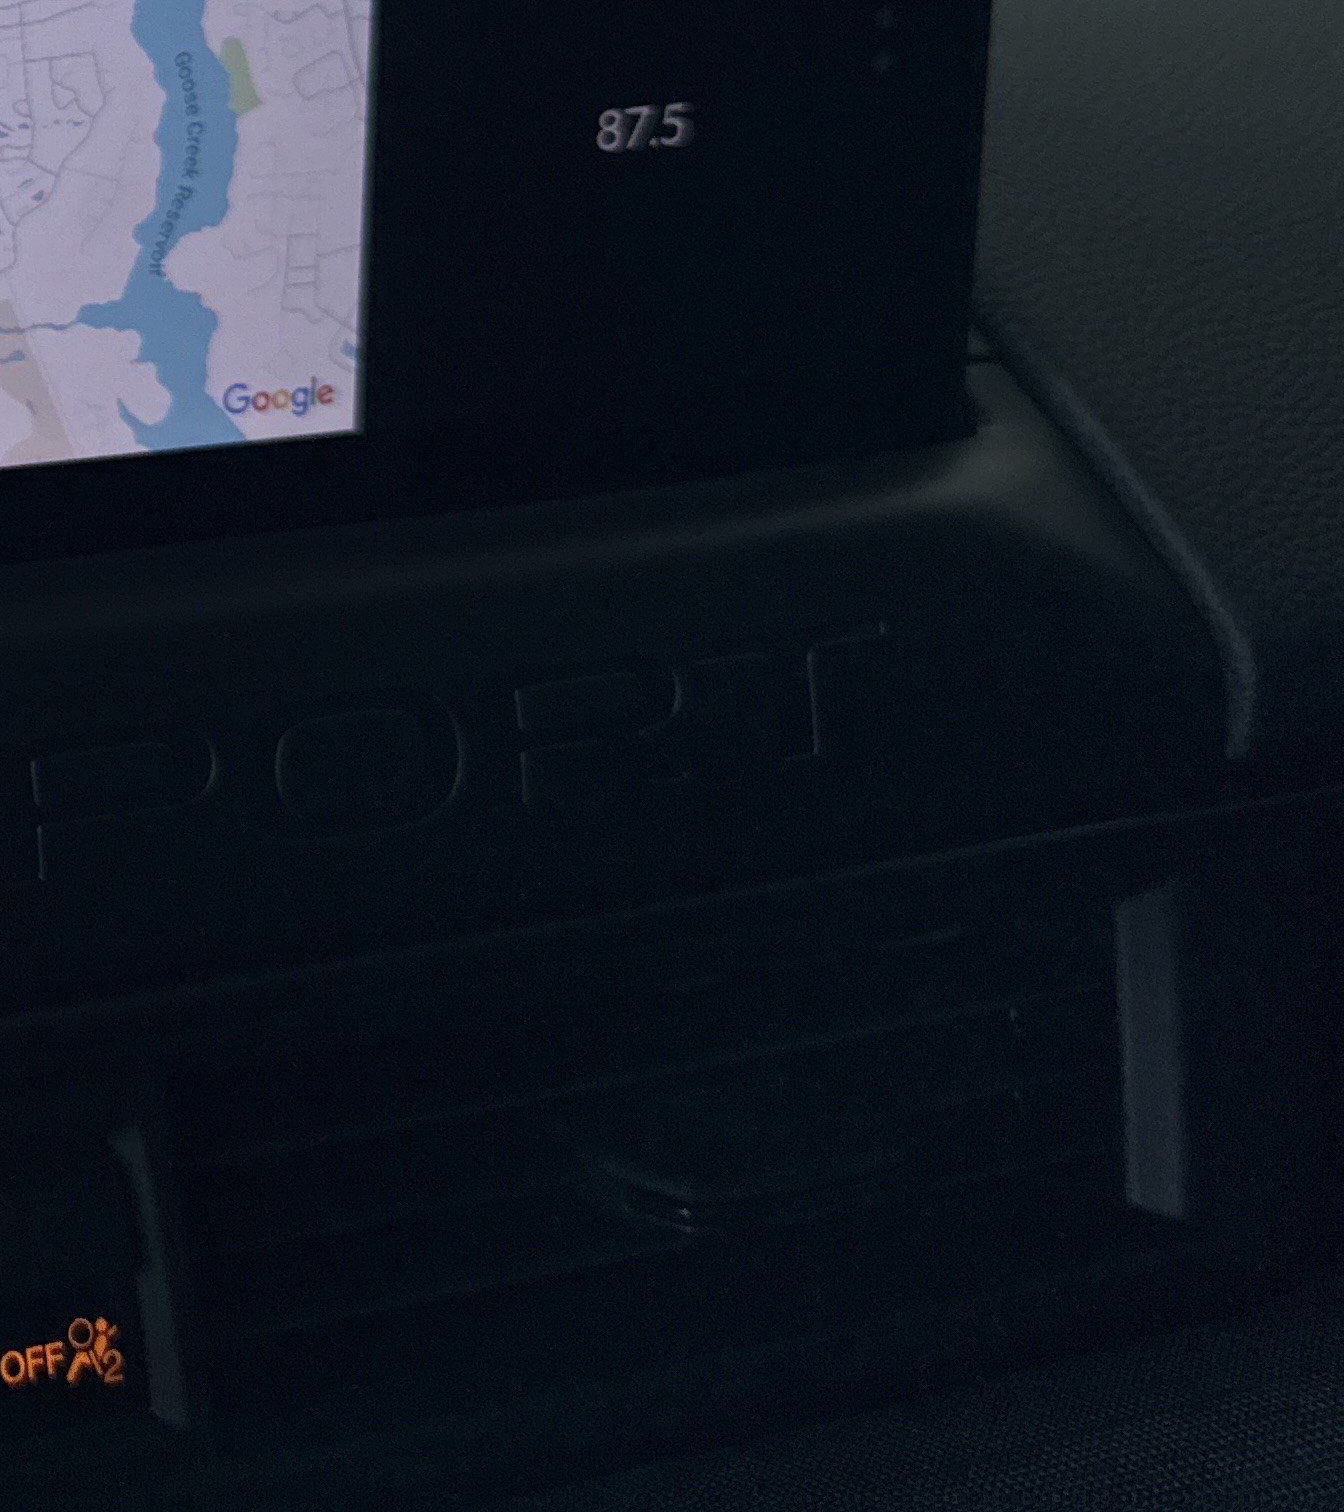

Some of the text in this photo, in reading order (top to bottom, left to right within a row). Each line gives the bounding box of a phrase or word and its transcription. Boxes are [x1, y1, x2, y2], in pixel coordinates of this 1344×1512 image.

[175, 51, 199, 117] Goose
[184, 122, 206, 179] Creek
[596, 102, 693, 152] 87.5
[223, 377, 335, 416] Google
[0, 1340, 66, 1388] OFF
